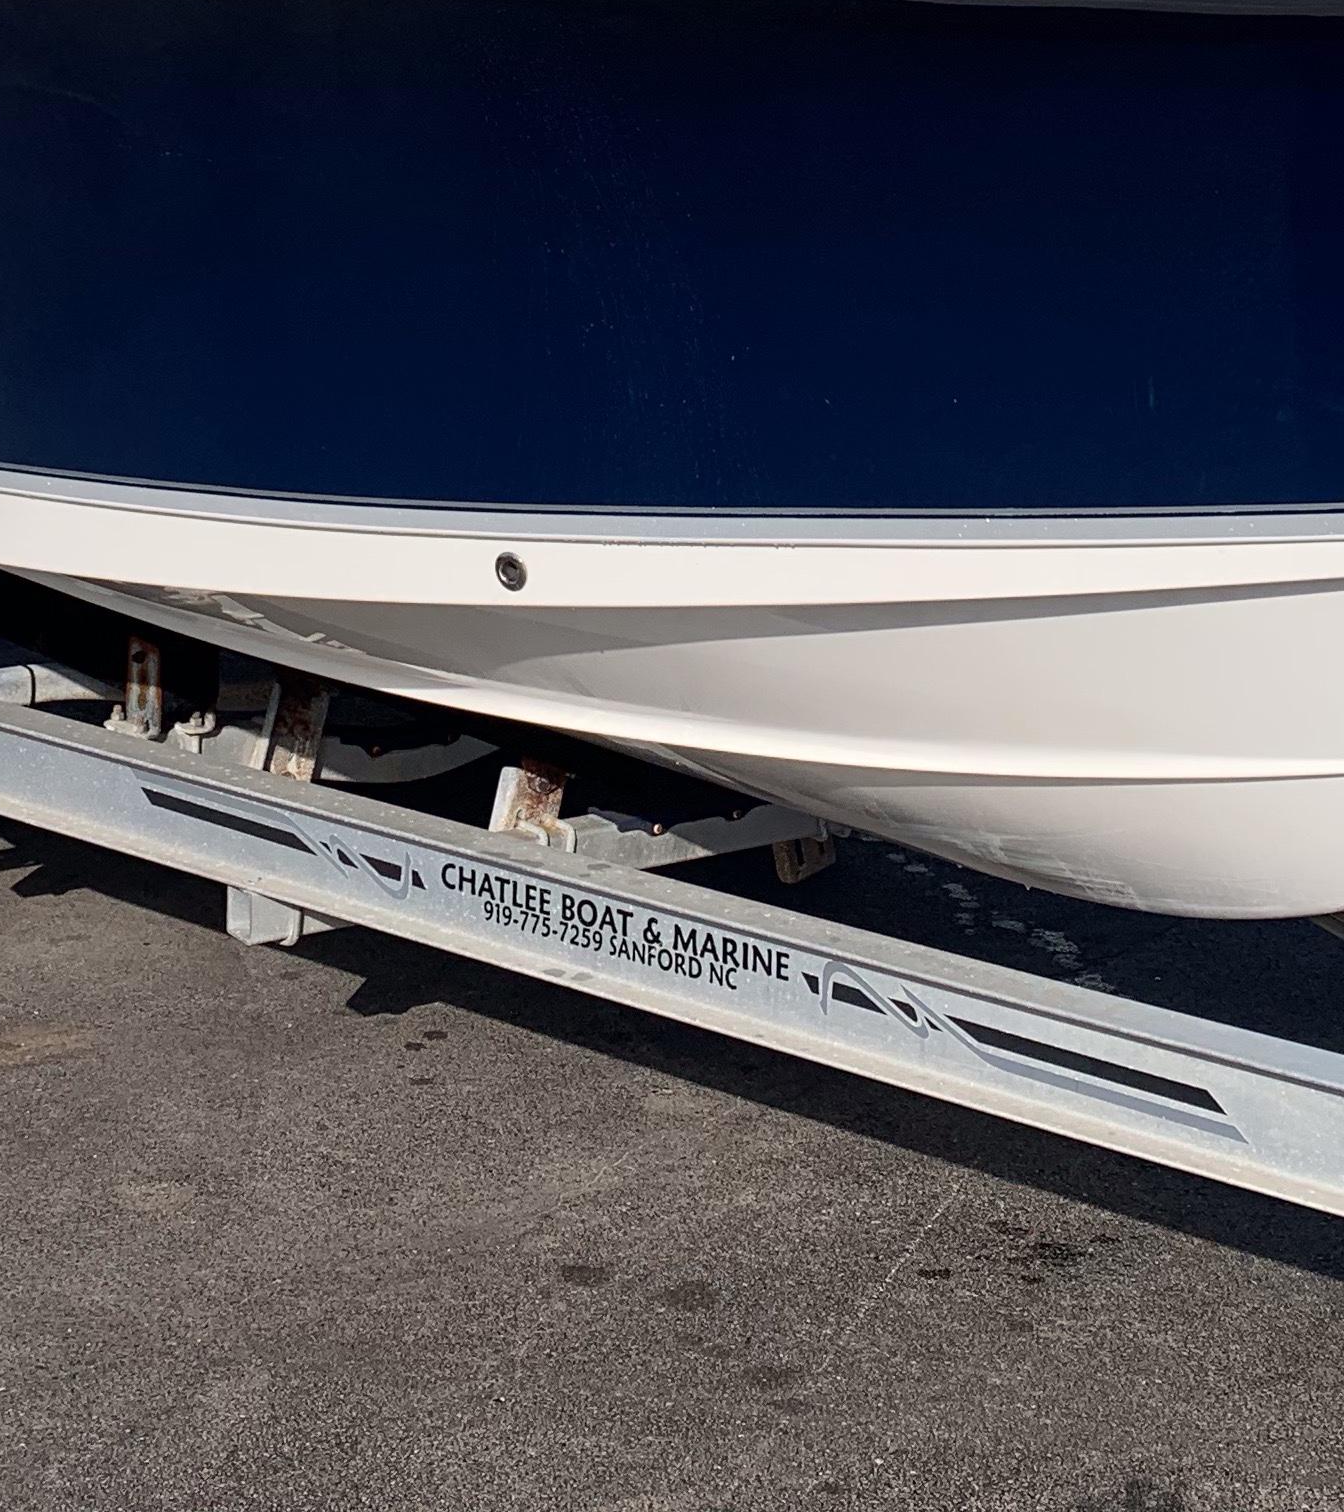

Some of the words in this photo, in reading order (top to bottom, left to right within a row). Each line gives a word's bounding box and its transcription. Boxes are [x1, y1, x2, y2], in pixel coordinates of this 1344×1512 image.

[441, 863, 551, 916] CHATLEE
[561, 893, 634, 937] BOAT
[643, 917, 662, 945] &
[672, 924, 790, 981] MARINE
[483, 900, 603, 952] 919-775-7259
[609, 935, 702, 979] SANFORD
[709, 962, 738, 990] NC
